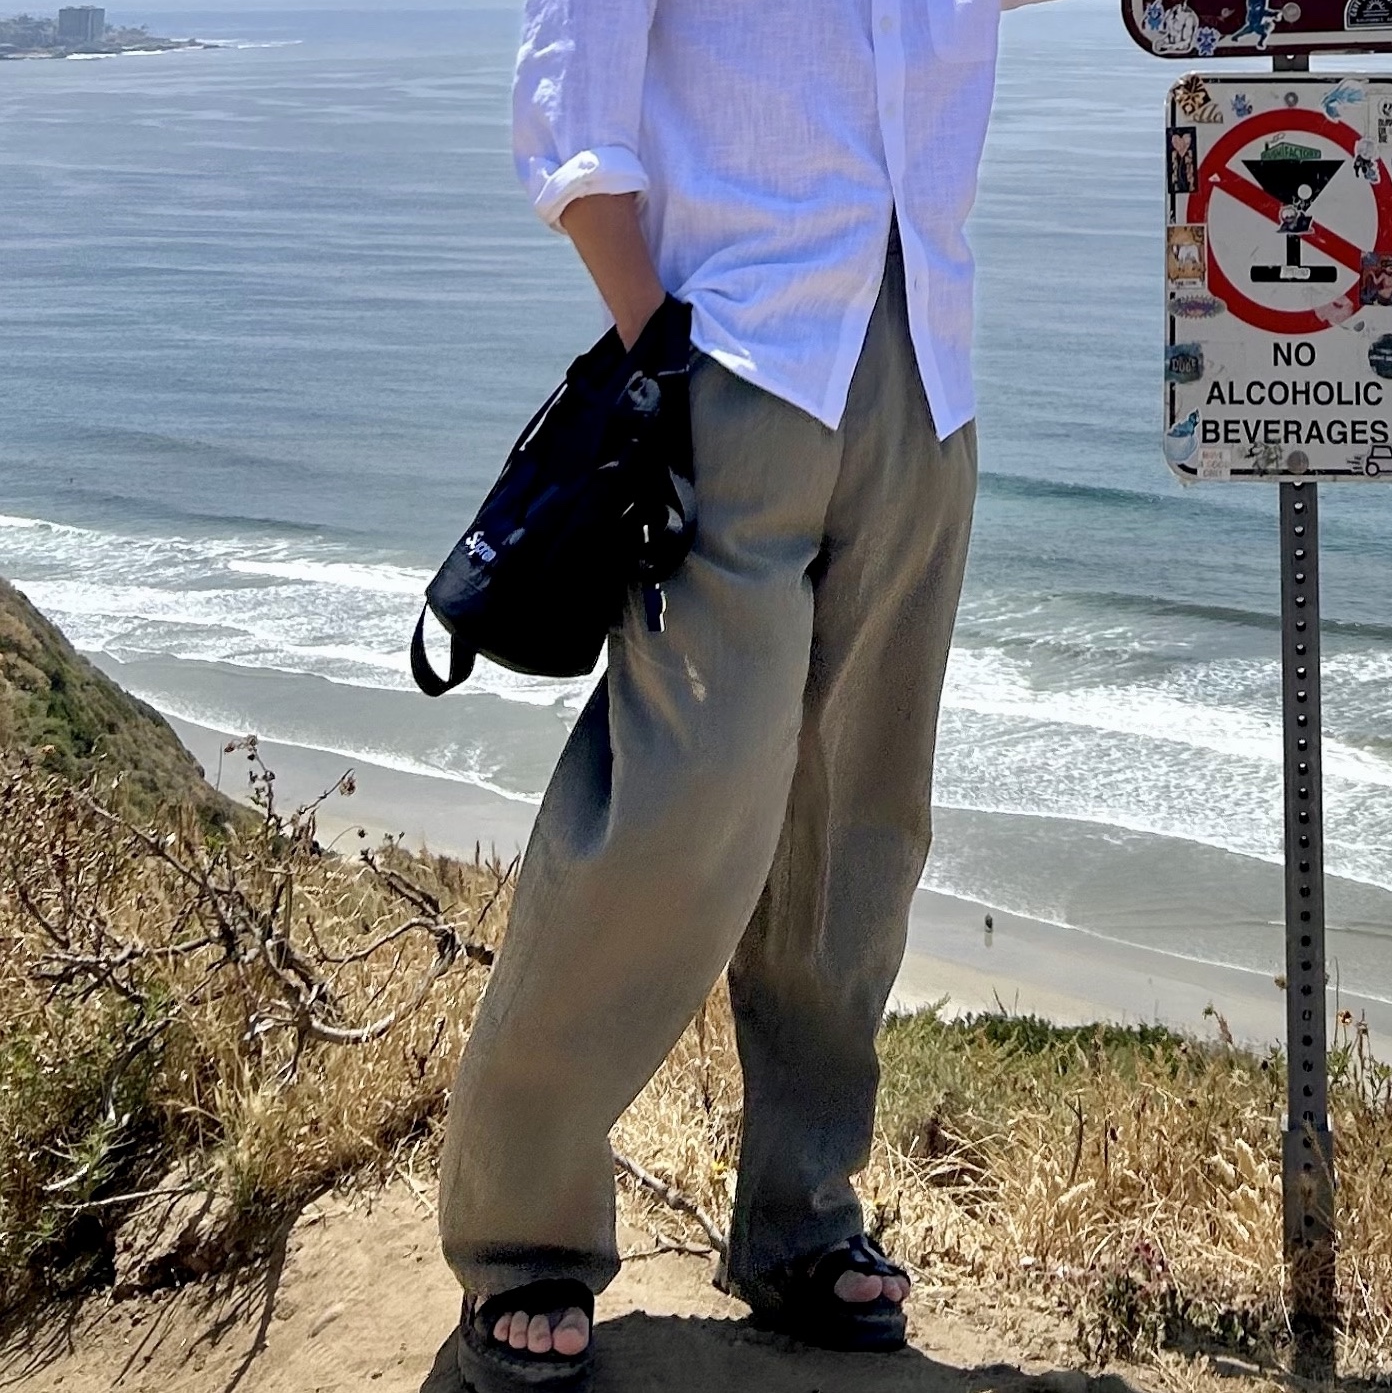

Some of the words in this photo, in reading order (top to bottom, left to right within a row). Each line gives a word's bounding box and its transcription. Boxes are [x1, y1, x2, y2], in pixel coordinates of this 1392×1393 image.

[1273, 342, 1316, 366] NO
[1206, 381, 1383, 406] ALCOHOLIC
[1202, 420, 1390, 444] BEVERAGES
